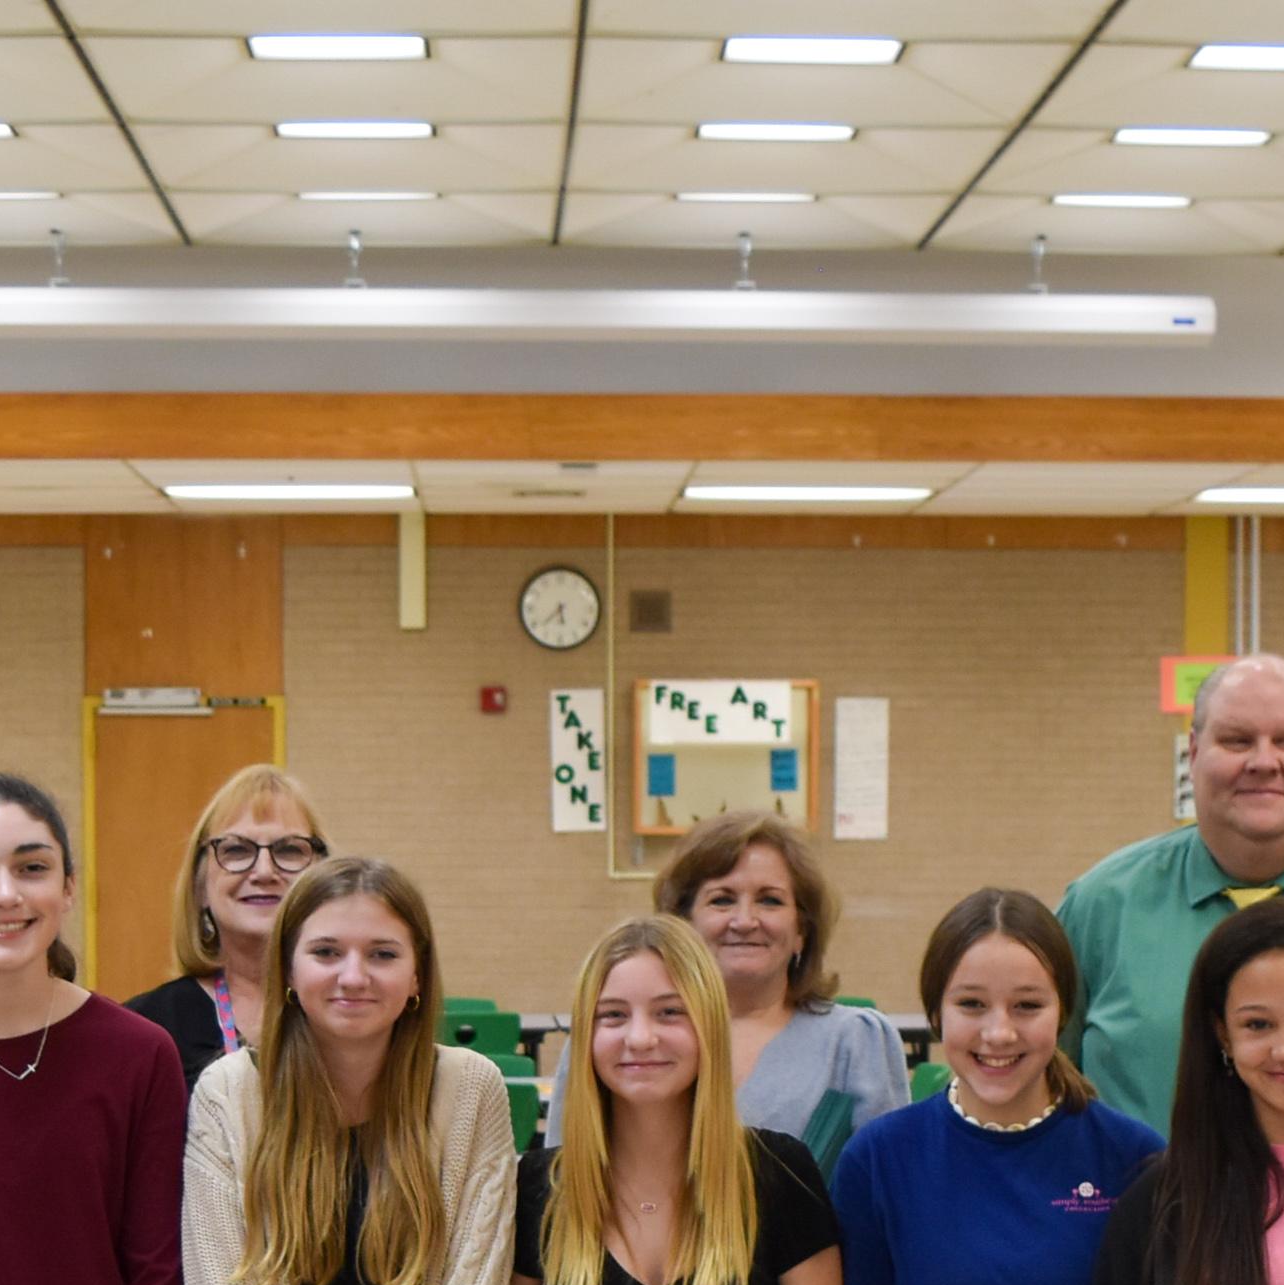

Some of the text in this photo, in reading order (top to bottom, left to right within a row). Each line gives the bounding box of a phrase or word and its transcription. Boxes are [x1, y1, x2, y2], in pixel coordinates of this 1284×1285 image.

[555, 694, 601, 771] TAKE
[654, 685, 786, 738] FREE ART
[554, 764, 602, 823] ONE
